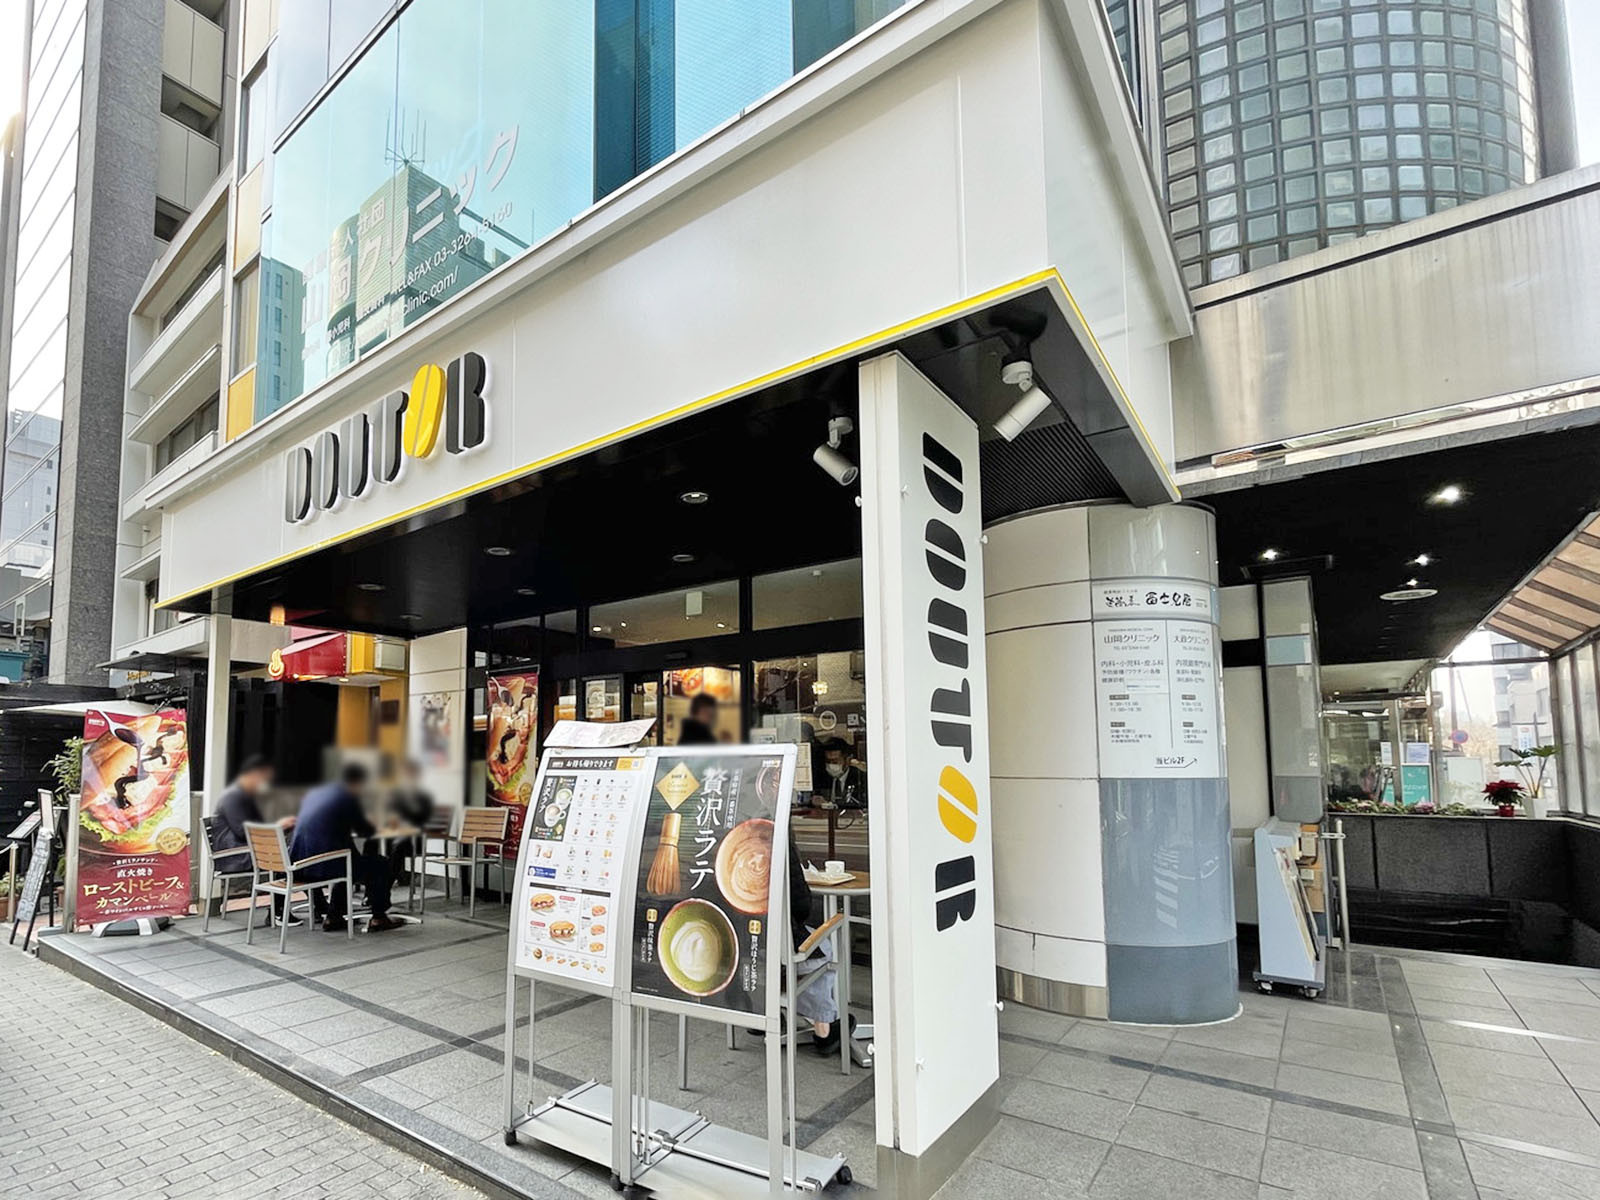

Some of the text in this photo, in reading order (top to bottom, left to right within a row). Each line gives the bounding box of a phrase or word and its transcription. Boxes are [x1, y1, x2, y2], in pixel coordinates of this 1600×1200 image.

[285, 351, 487, 523] DOUTOR
[1103, 634, 1160, 645] 山岡クリニック
[921, 430, 979, 933] DOUTOR
[690, 766, 727, 891] 贅沢ラテ
[83, 876, 185, 897] ローストビーフ&
[116, 867, 153, 879] 直火焼き
